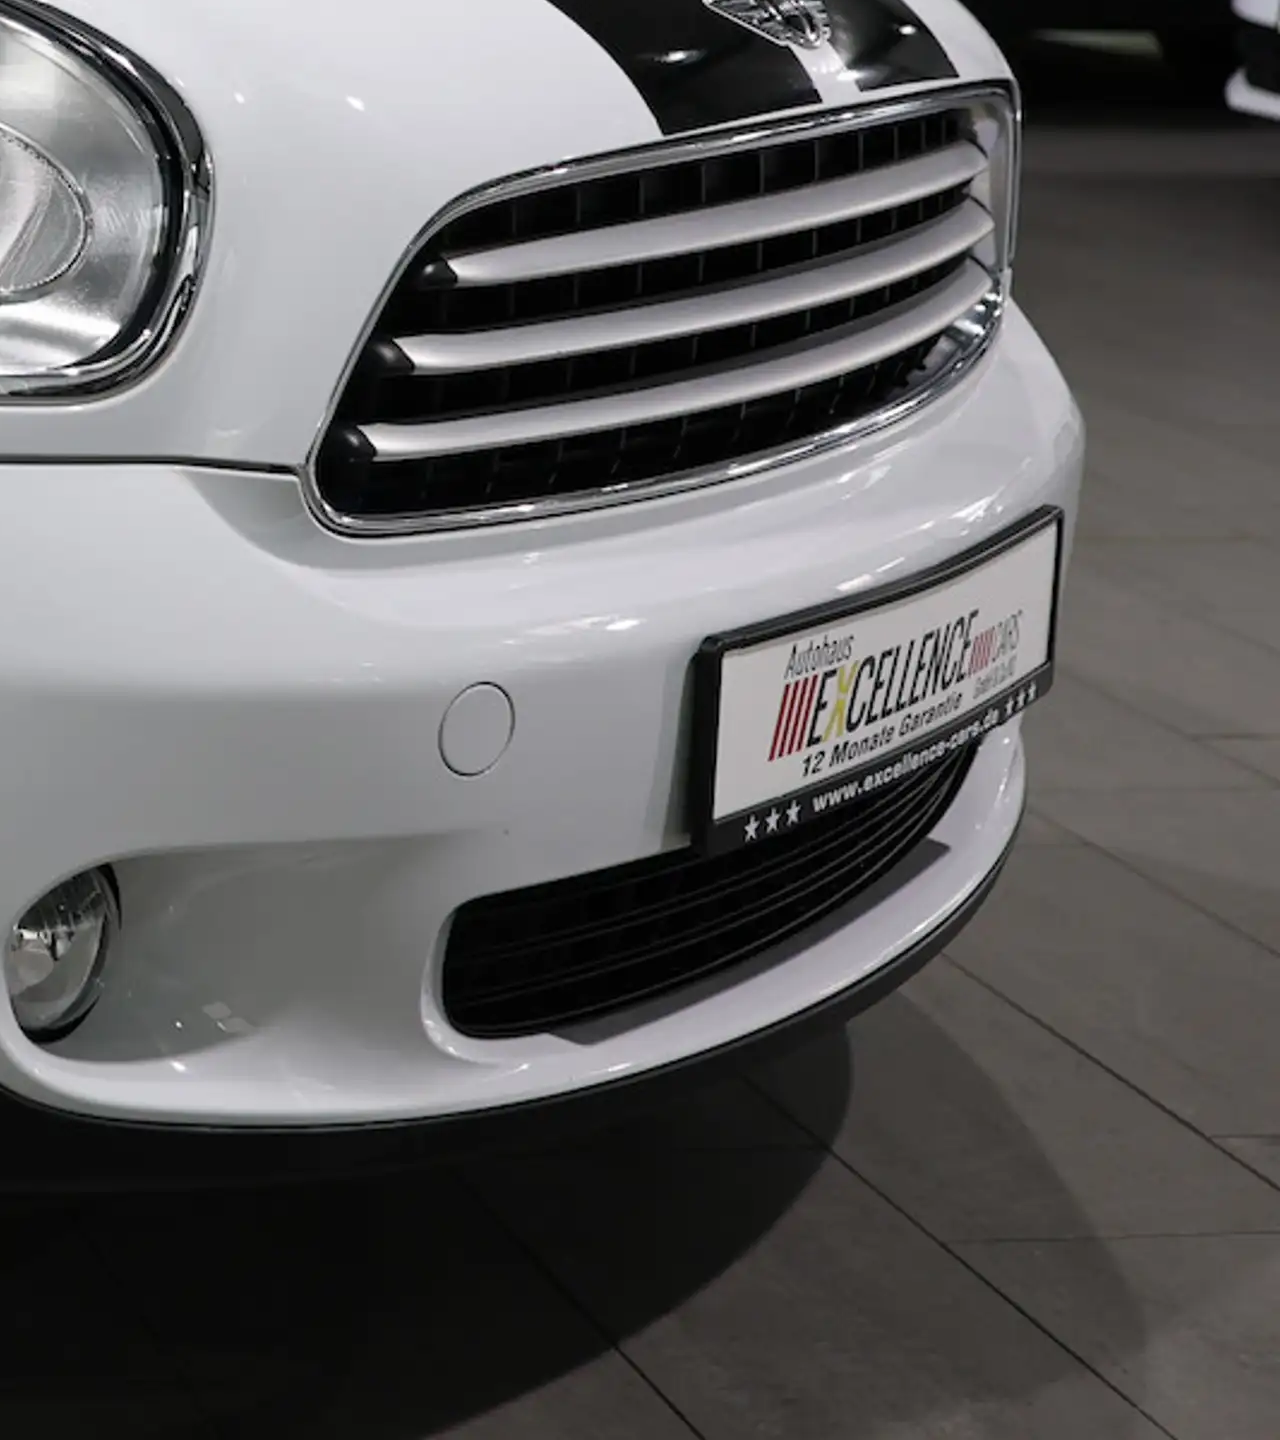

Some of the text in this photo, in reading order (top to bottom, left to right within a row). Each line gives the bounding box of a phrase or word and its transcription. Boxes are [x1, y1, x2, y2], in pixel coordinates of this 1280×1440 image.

[784, 634, 855, 680] Autohaus
[806, 609, 980, 747] EXCELLENCE
[802, 691, 963, 777] 12 Monate Garantie
[812, 708, 1000, 813] www.excellence-cars.de
